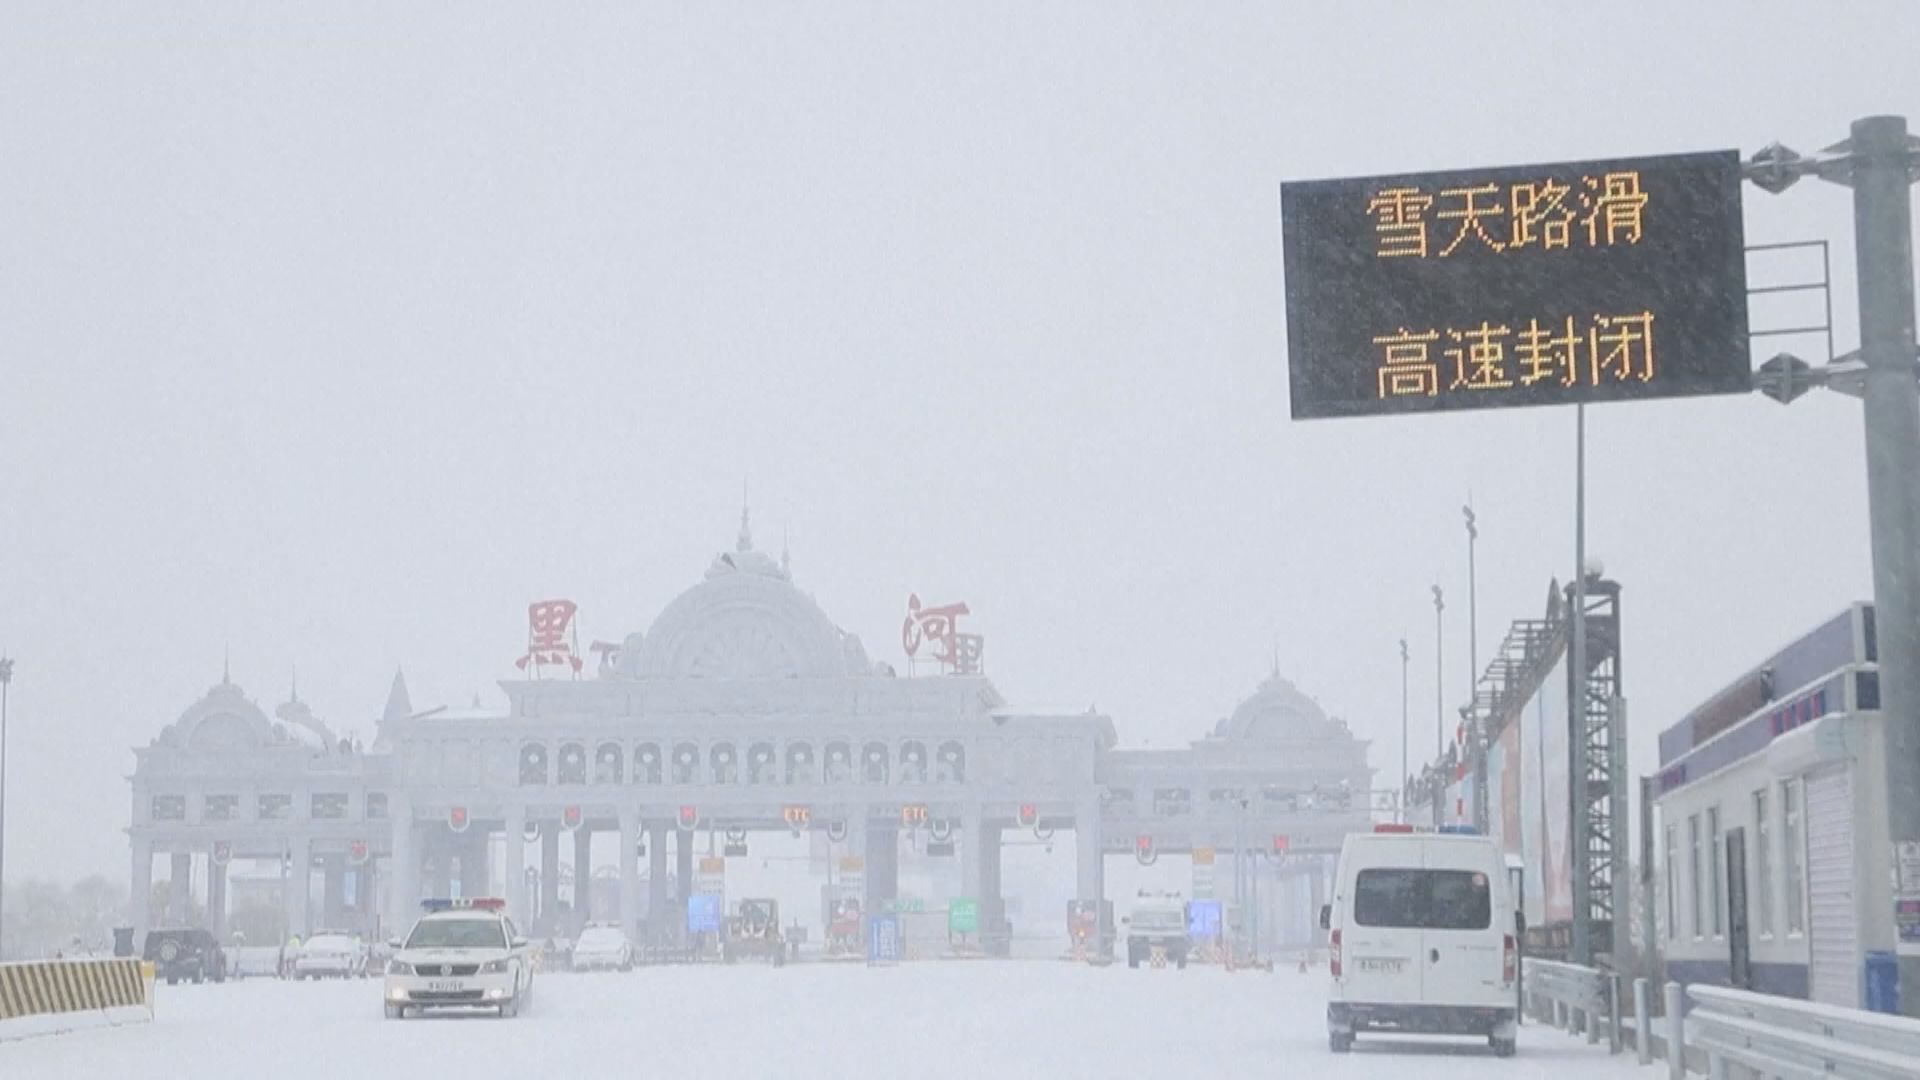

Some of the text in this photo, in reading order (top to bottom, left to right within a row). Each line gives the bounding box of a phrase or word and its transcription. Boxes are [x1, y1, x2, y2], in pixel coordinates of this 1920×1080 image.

[1367, 171, 1649, 258] 雪天路滑
[1373, 311, 1655, 399] 高速封闭
[784, 807, 809, 822] ETC
[903, 807, 928, 822] ETC
